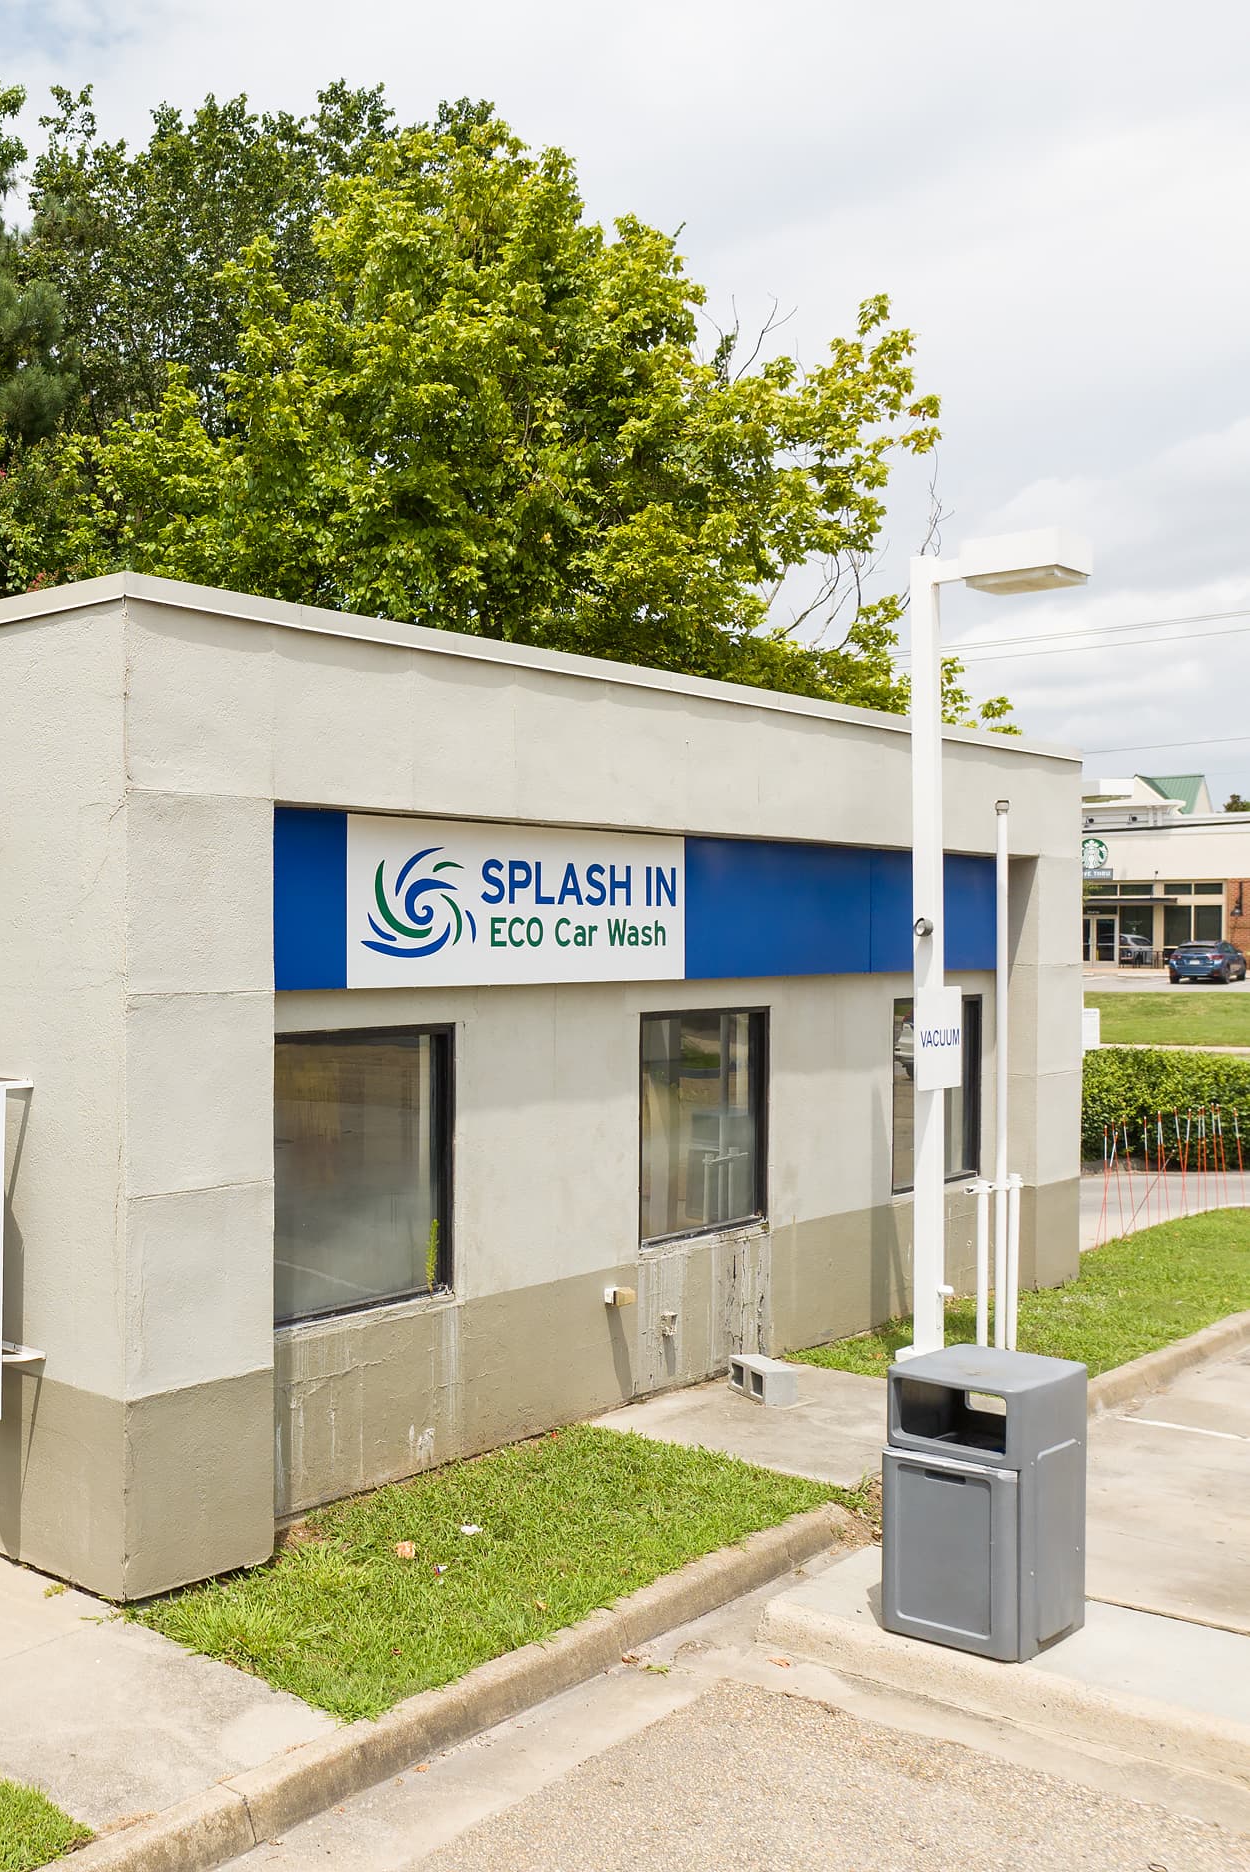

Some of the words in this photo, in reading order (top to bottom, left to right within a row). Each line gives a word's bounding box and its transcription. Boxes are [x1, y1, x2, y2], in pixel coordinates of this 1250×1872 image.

[481, 858, 631, 907] SPLASH
[646, 866, 676, 907] IN
[490, 917, 543, 948] ECO
[555, 917, 598, 947] Car
[607, 919, 666, 947] Wash
[920, 1029, 960, 1048] VACUUM
